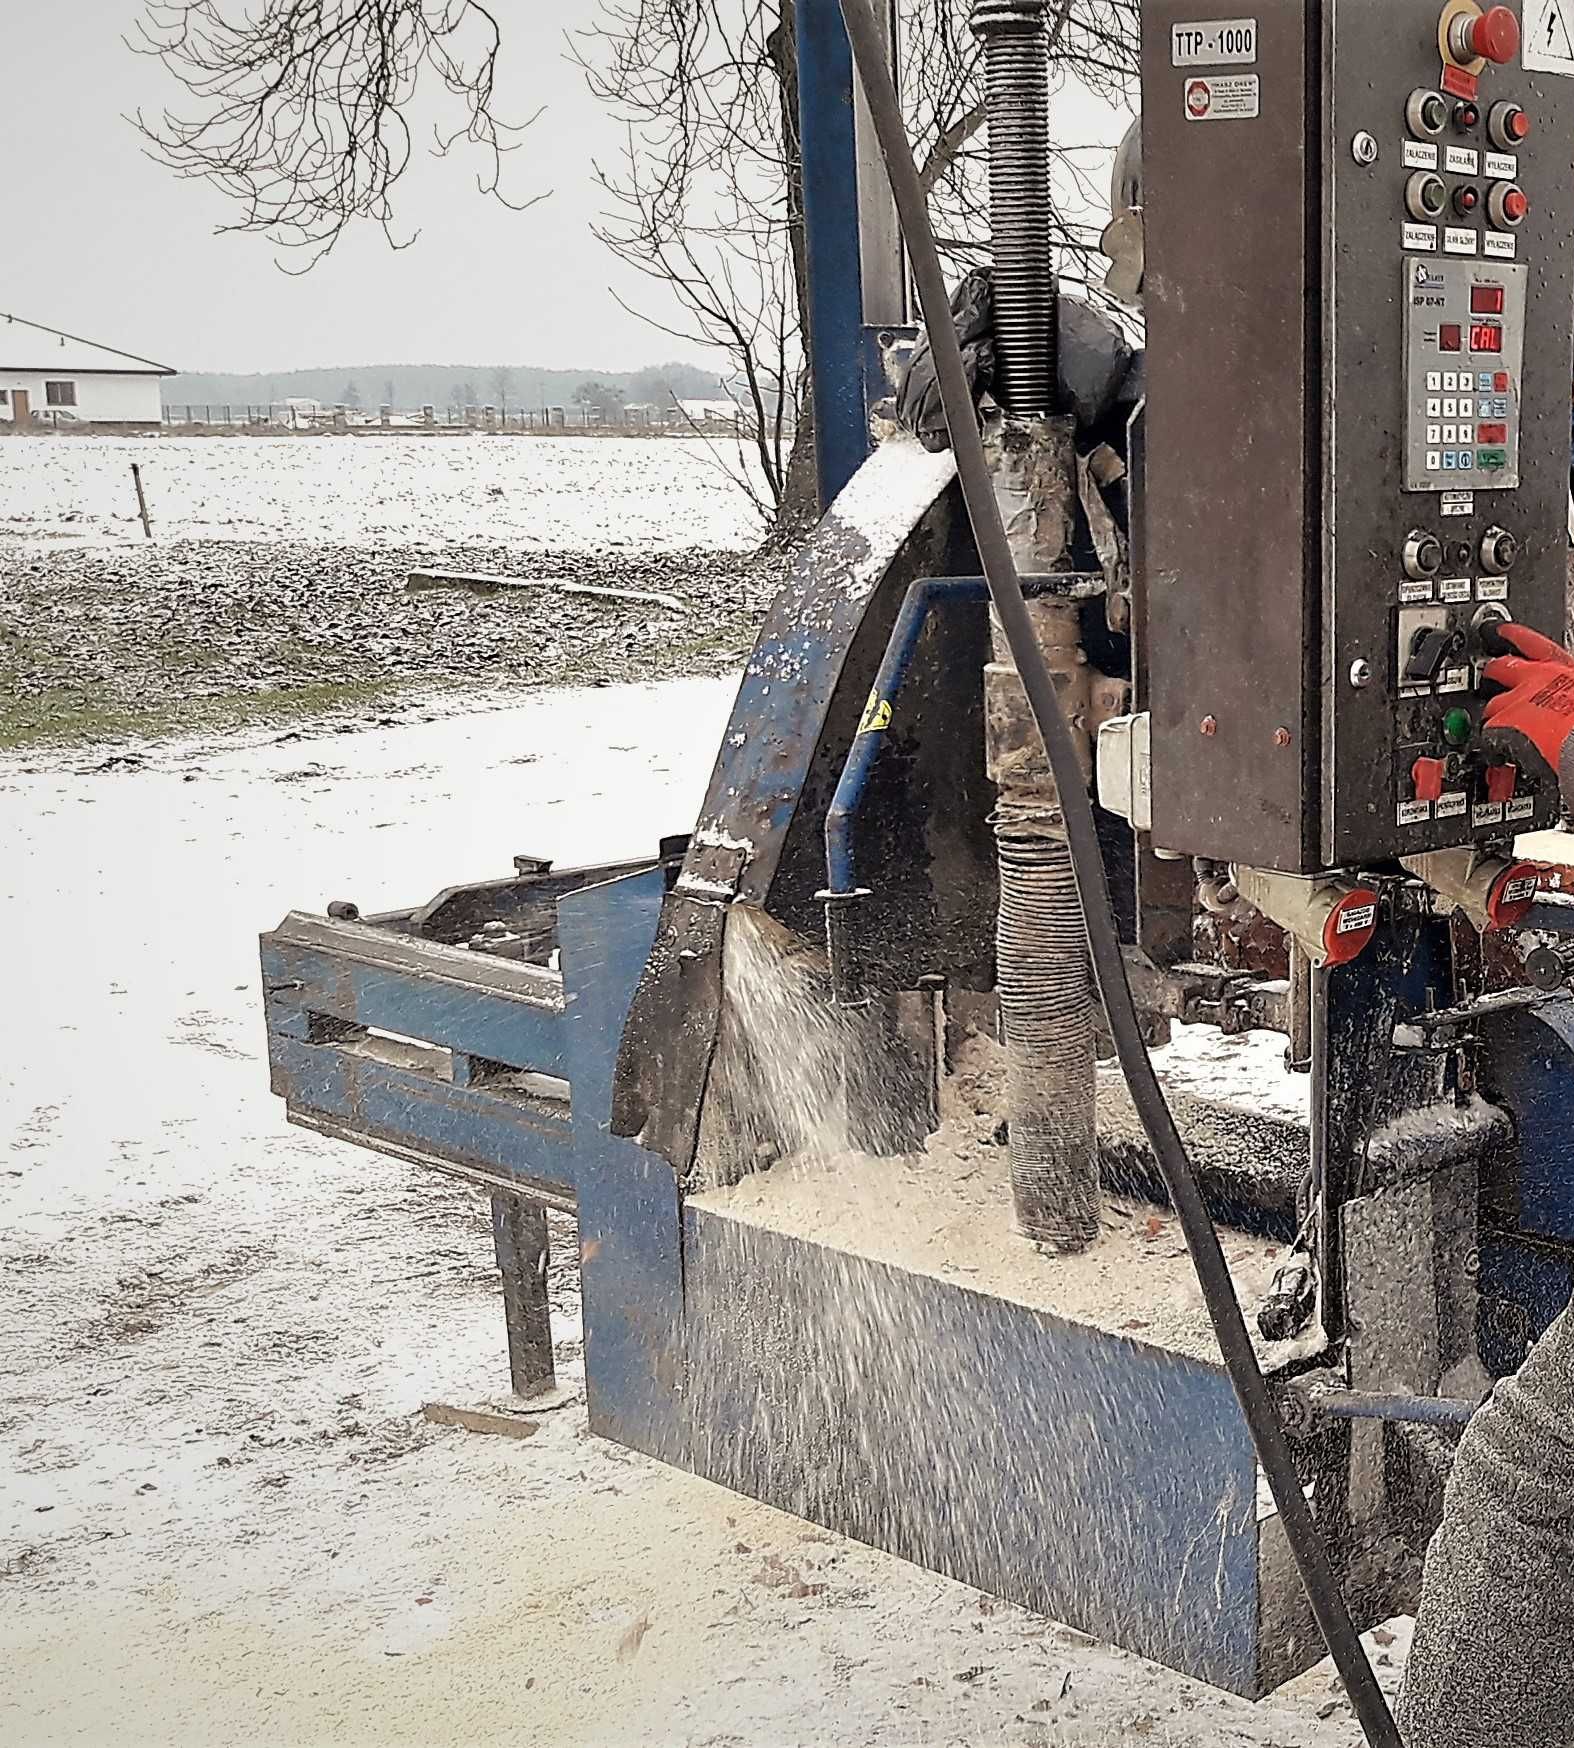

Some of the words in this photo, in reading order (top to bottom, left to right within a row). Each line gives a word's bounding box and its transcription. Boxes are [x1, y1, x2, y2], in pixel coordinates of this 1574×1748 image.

[1175, 31, 1203, 56] TTP
[1218, 29, 1252, 54] 1000
[1470, 326, 1498, 350] CAL
[1431, 376, 1436, 387] 1
[1447, 376, 1453, 387] 2
[1463, 376, 1469, 387] 3
[1431, 402, 1436, 412] 4
[1447, 402, 1453, 412] 5
[1463, 402, 1468, 412] 6
[1431, 429, 1436, 439] 7
[1447, 429, 1452, 439] 8
[1463, 429, 1468, 439] 9
[1431, 455, 1436, 465] 0
